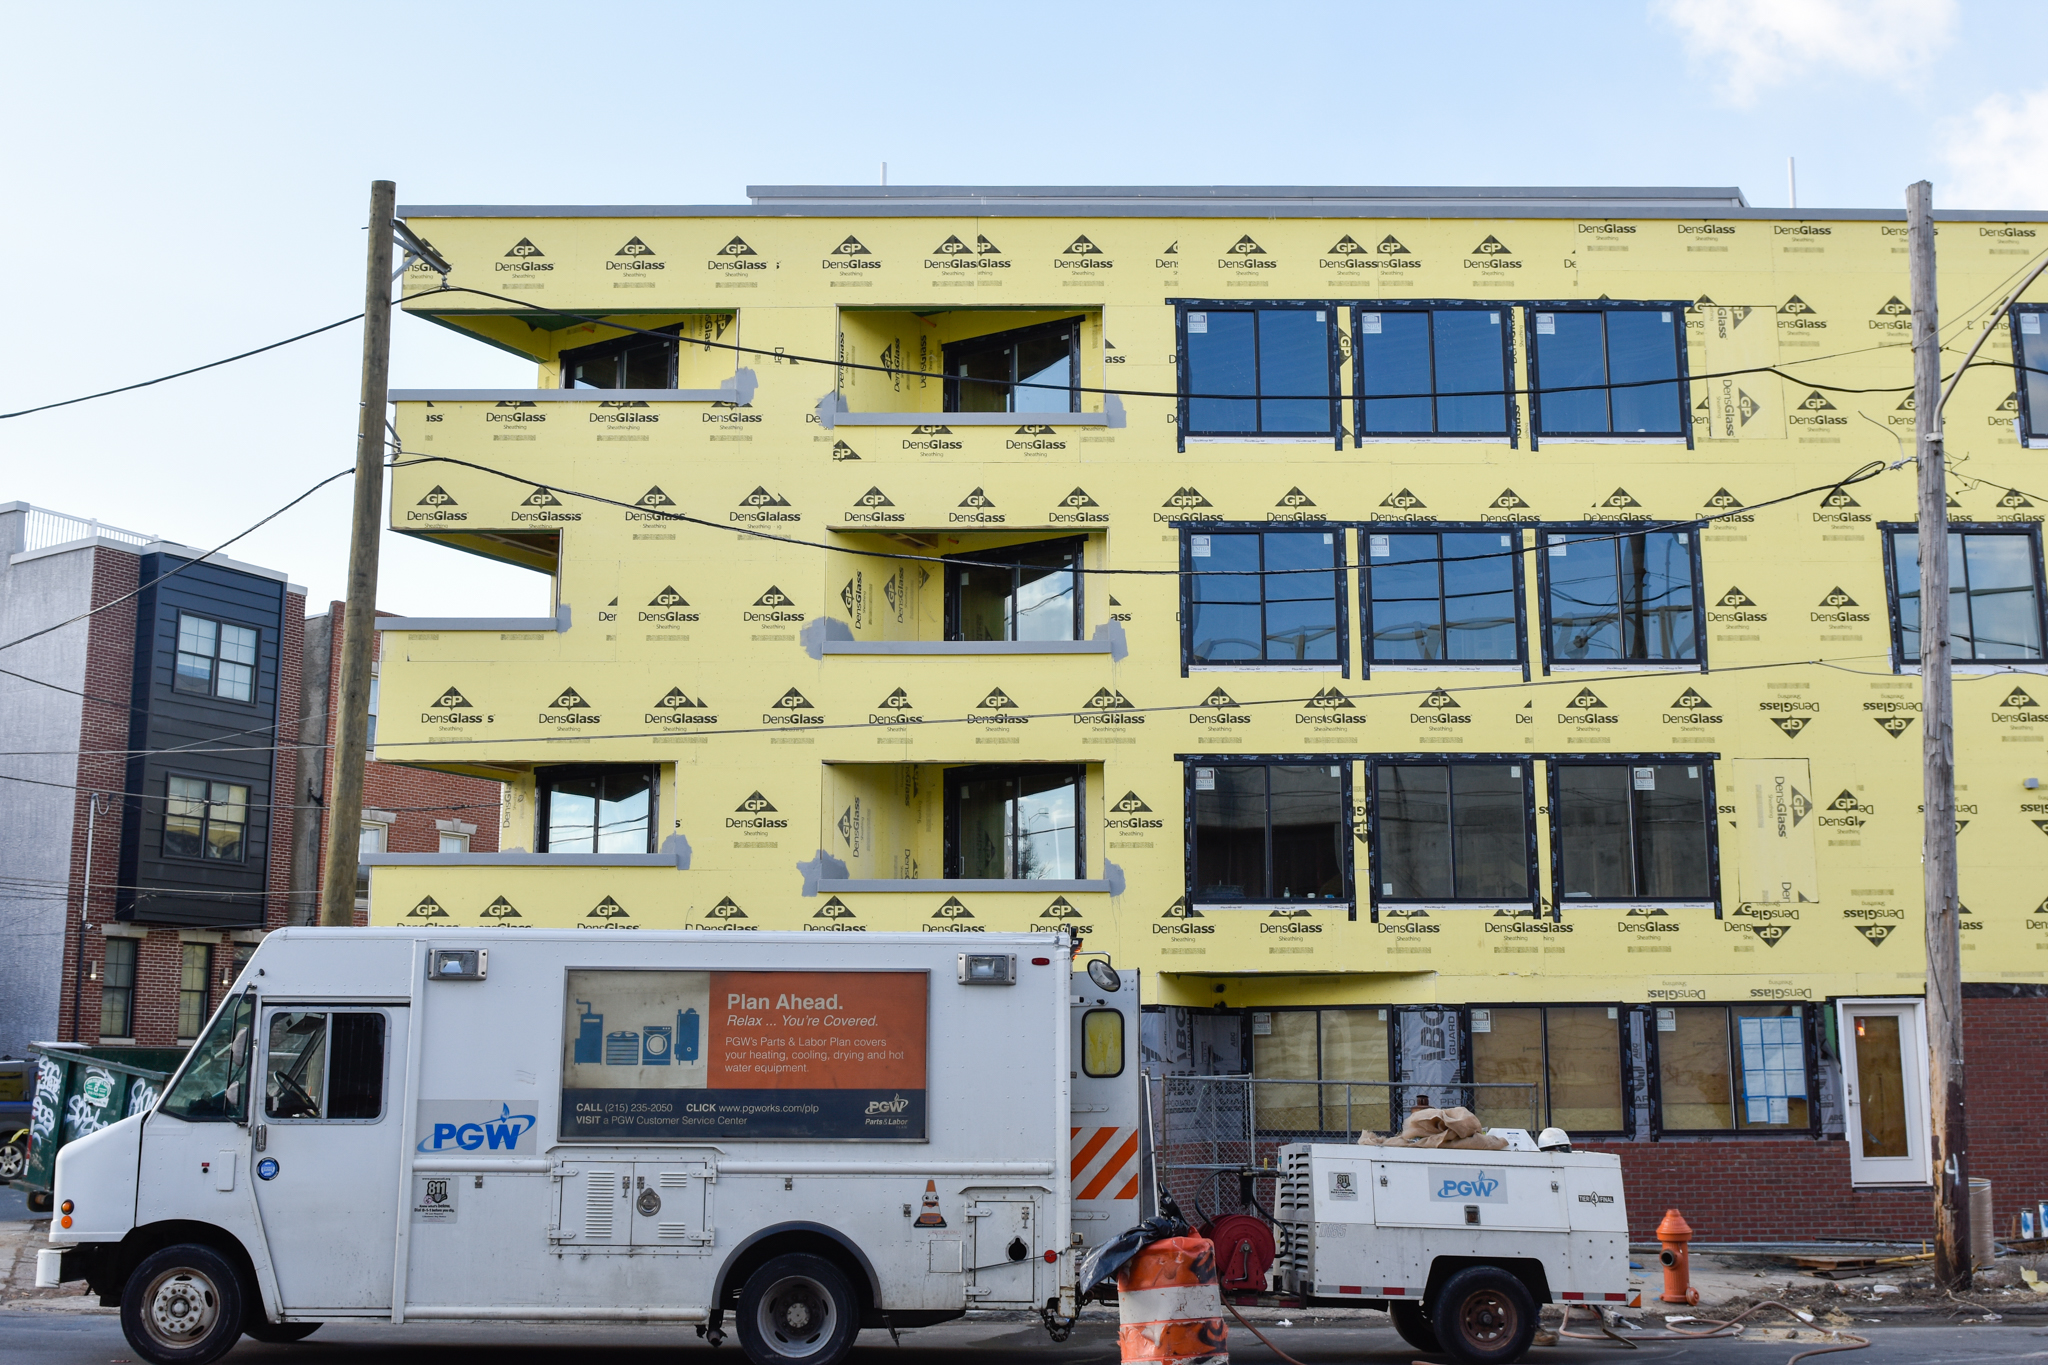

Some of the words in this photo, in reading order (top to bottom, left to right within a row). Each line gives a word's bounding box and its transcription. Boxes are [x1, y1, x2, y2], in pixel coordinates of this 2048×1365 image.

[1578, 224, 1636, 233] DensGlass
[1678, 225, 1735, 233] DensGlass
[1774, 226, 1831, 235] DensGlass
[1980, 228, 2036, 237] DensGlass
[513, 246, 534, 256] GP
[840, 243, 861, 253] GP
[1072, 243, 1093, 252] GP
[1235, 243, 1256, 252] GP
[1480, 243, 1501, 252] GP
[495, 262, 555, 271] DensGlass
[606, 261, 666, 270] DensGlass
[708, 261, 765, 269] DensGlass
[823, 260, 882, 269] DensGlass
[1054, 259, 1114, 268] DensGlass
[1218, 259, 1277, 268] DensGlass
[1320, 259, 1378, 268] DensGlass
[1464, 259, 1522, 268] DensGlass
[1777, 319, 1827, 328] ensGlass
[1723, 380, 1735, 437] DensGlass
[1805, 399, 1827, 409] GP
[486, 413, 547, 422] DensGlass
[703, 413, 763, 422] DensGlass
[1789, 415, 1847, 424] DensGlass
[903, 440, 963, 449] DensGlass
[1006, 440, 1067, 449] DensGlass
[426, 494, 448, 504] GP
[863, 495, 885, 505] GP
[1830, 496, 1851, 507] GP
[407, 511, 468, 520] DensGlass
[845, 512, 906, 521] DensGlass
[1049, 513, 1110, 522] DensGlass
[1813, 513, 1871, 522] DensGlass
[657, 595, 679, 605] GP
[1828, 595, 1849, 605] GP
[639, 612, 701, 621] DensGlass
[744, 612, 806, 621] DensGlass
[1708, 612, 1768, 621] DensGlass
[1811, 612, 1870, 621] DensGlass
[558, 696, 580, 706] GP
[1208, 696, 1229, 706] GP
[1575, 696, 1597, 707] GP
[1759, 702, 1819, 712] DensGlass
[421, 713, 484, 723] DensGlass
[539, 714, 602, 723] DensGlass
[763, 714, 823, 724] DensGlass
[1190, 714, 1252, 723] DensGlass
[1410, 714, 1472, 723] DensGlass
[1558, 714, 1619, 723] DensGlass
[1663, 714, 1723, 723] DensGlass
[1781, 719, 1802, 729] GP
[744, 800, 767, 810] GP
[1774, 776, 1787, 838] DensGlass
[726, 818, 789, 828] DensGlass
[417, 905, 440, 915] GP
[822, 906, 845, 916] GP
[1843, 910, 1904, 919] DensGlass
[1153, 924, 1216, 934] DensGlass
[1260, 923, 1323, 933] DensGlass
[1378, 923, 1441, 933] DensGlass
[1618, 922, 1680, 932] DensGlass
[1865, 927, 1887, 937] GP
[1750, 988, 1812, 999] DensGlass
[727, 994, 770, 1010] Plan
[776, 994, 843, 1010] Ahead.
[727, 1015, 762, 1026] Relax
[783, 1015, 819, 1026] You're
[824, 1015, 878, 1026] Covered.
[1448, 1016, 1456, 1056] GUARD
[726, 1037, 757, 1046] PGW's
[761, 1037, 785, 1046] Parts
[789, 1037, 795, 1046] &
[799, 1037, 827, 1046] Labor
[830, 1037, 850, 1046] Plan
[725, 1052, 746, 1061] your
[750, 1051, 788, 1061] heating,
[792, 1051, 830, 1061] cooling,
[834, 1051, 864, 1061] drying
[867, 1051, 885, 1059] and
[889, 1051, 904, 1059] hot
[725, 1064, 751, 1072] water
[755, 1064, 809, 1074] equipment.
[576, 1104, 602, 1112] CALL
[605, 1104, 628, 1113] (215)
[631, 1104, 672, 1112] 235-2050
[686, 1104, 716, 1112] CLICK
[719, 1104, 819, 1114] www.pgworks.com/plp
[870, 1101, 904, 1112] PGW
[576, 1116, 601, 1124] VISIT
[612, 1116, 634, 1124] PGW
[636, 1116, 679, 1125] Customer
[682, 1116, 715, 1125] Service
[718, 1117, 747, 1125] Center
[433, 1124, 521, 1150] PGW
[428, 1180, 446, 1195] 811
[1443, 1180, 1494, 1197] PGW
